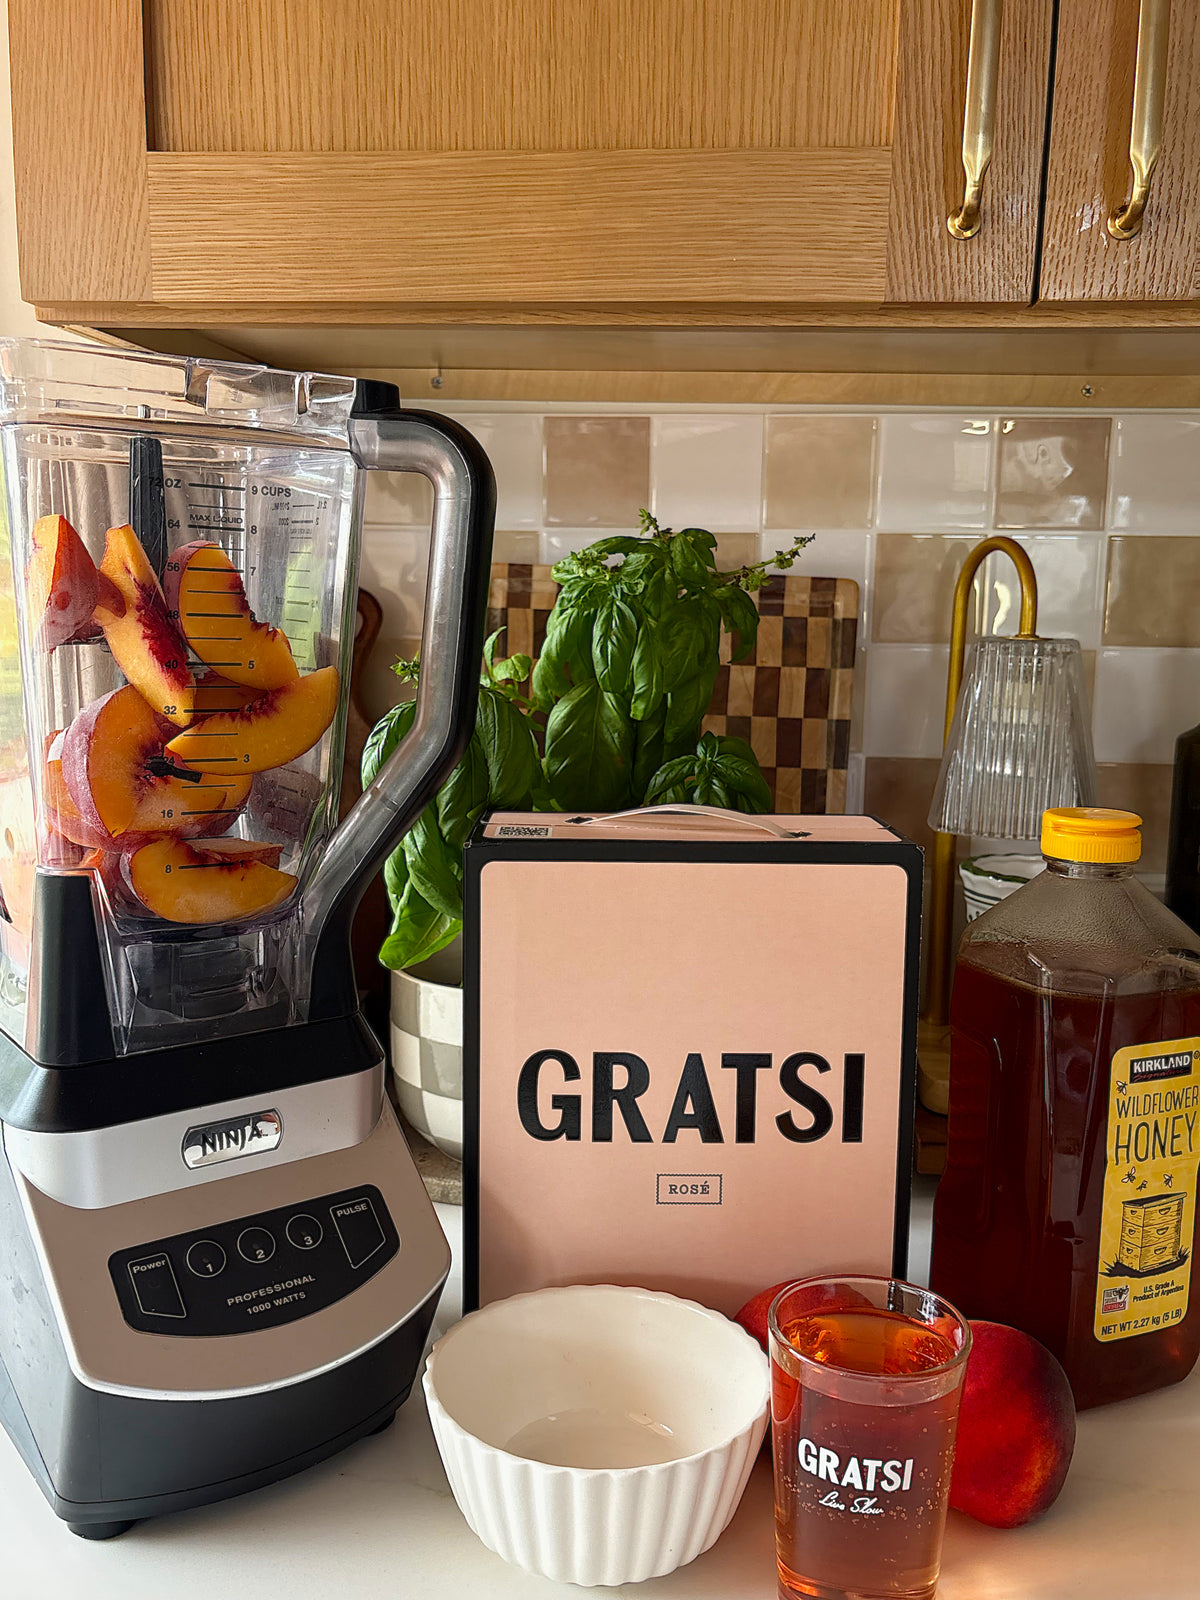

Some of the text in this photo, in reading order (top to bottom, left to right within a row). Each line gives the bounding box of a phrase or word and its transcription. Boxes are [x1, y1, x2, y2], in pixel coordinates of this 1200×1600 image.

[164, 478, 182, 488] OZ
[251, 485, 292, 498] 9 CUPS
[189, 514, 211, 522] MAX
[167, 519, 181, 529] 64
[250, 526, 258, 535] 8
[166, 562, 180, 572] 56
[250, 567, 257, 576] 7
[166, 610, 180, 620] 48
[165, 660, 178, 669] 40
[248, 661, 255, 670] 5
[163, 706, 177, 715] 32
[243, 754, 250, 763] 3
[160, 810, 174, 818] 16
[241, 806, 248, 814] 2
[165, 865, 172, 873] 8
[1133, 1055, 1191, 1074] KIRKLAND
[516, 1048, 866, 1144] GRATSI
[1116, 1085, 1199, 1119] WILDFLOWER
[202, 1122, 262, 1157] NINJA
[1115, 1111, 1197, 1166] HONEY
[668, 1180, 710, 1194] ROSÉ
[336, 1203, 368, 1217] PULSE
[304, 1236, 313, 1245] 3
[256, 1249, 265, 1259] 2
[132, 1259, 166, 1274] Power
[206, 1263, 213, 1273] 1
[227, 1274, 316, 1306] PROFESSIONAL
[1155, 1282, 1170, 1291] Grade
[1132, 1293, 1154, 1302] Product
[1160, 1285, 1184, 1296] Argentina
[246, 1292, 306, 1315] 1000 WATTS
[1101, 1308, 1182, 1335] NET WT 2.27 kg (5 LB)
[798, 1438, 914, 1492] GRATSI
[818, 1491, 884, 1514] Live Slow
